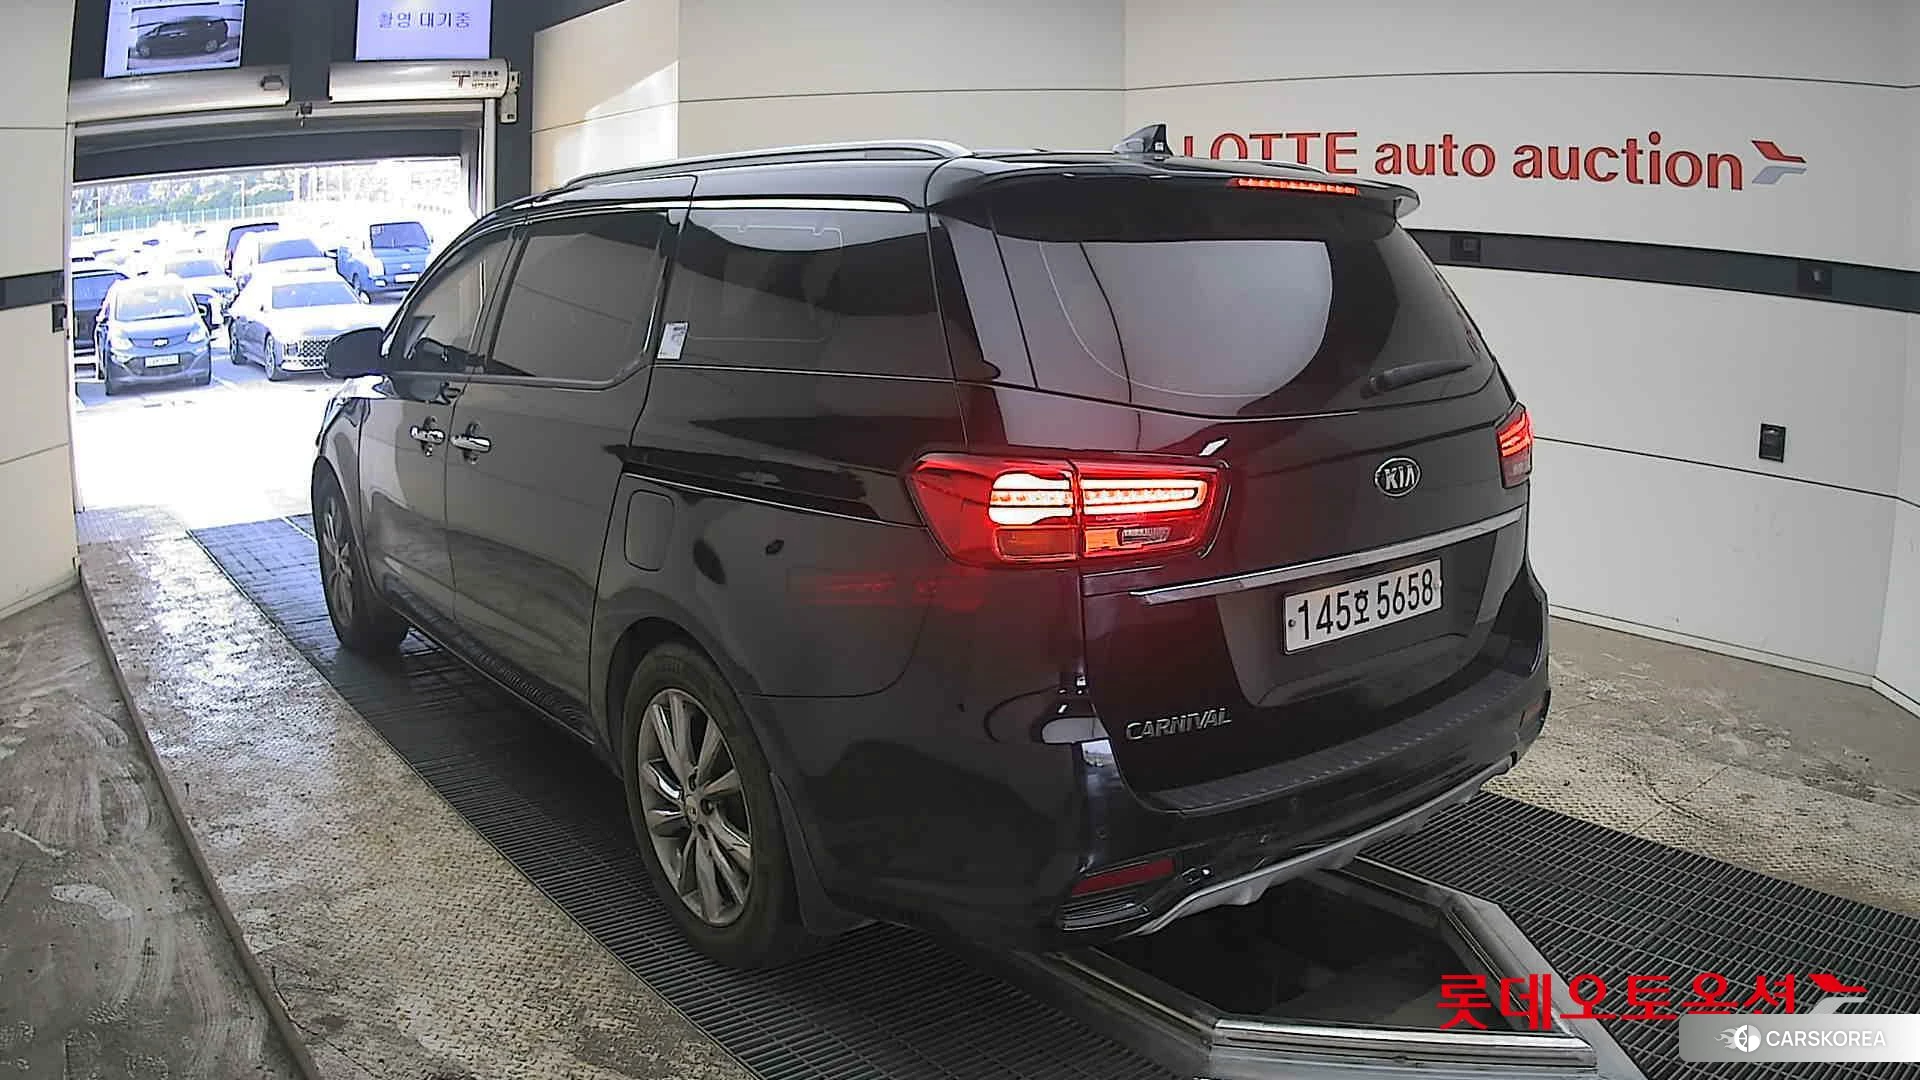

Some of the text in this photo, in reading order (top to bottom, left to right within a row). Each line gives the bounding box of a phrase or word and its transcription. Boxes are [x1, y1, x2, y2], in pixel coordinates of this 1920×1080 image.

[420, 12, 470, 29] 대기중
[1375, 134, 1496, 178] auto
[1512, 131, 1744, 191] auction
[1383, 464, 1415, 491] KIA
[1298, 568, 1434, 641] 145호 5658
[1126, 707, 1233, 741] CARNIVAL
